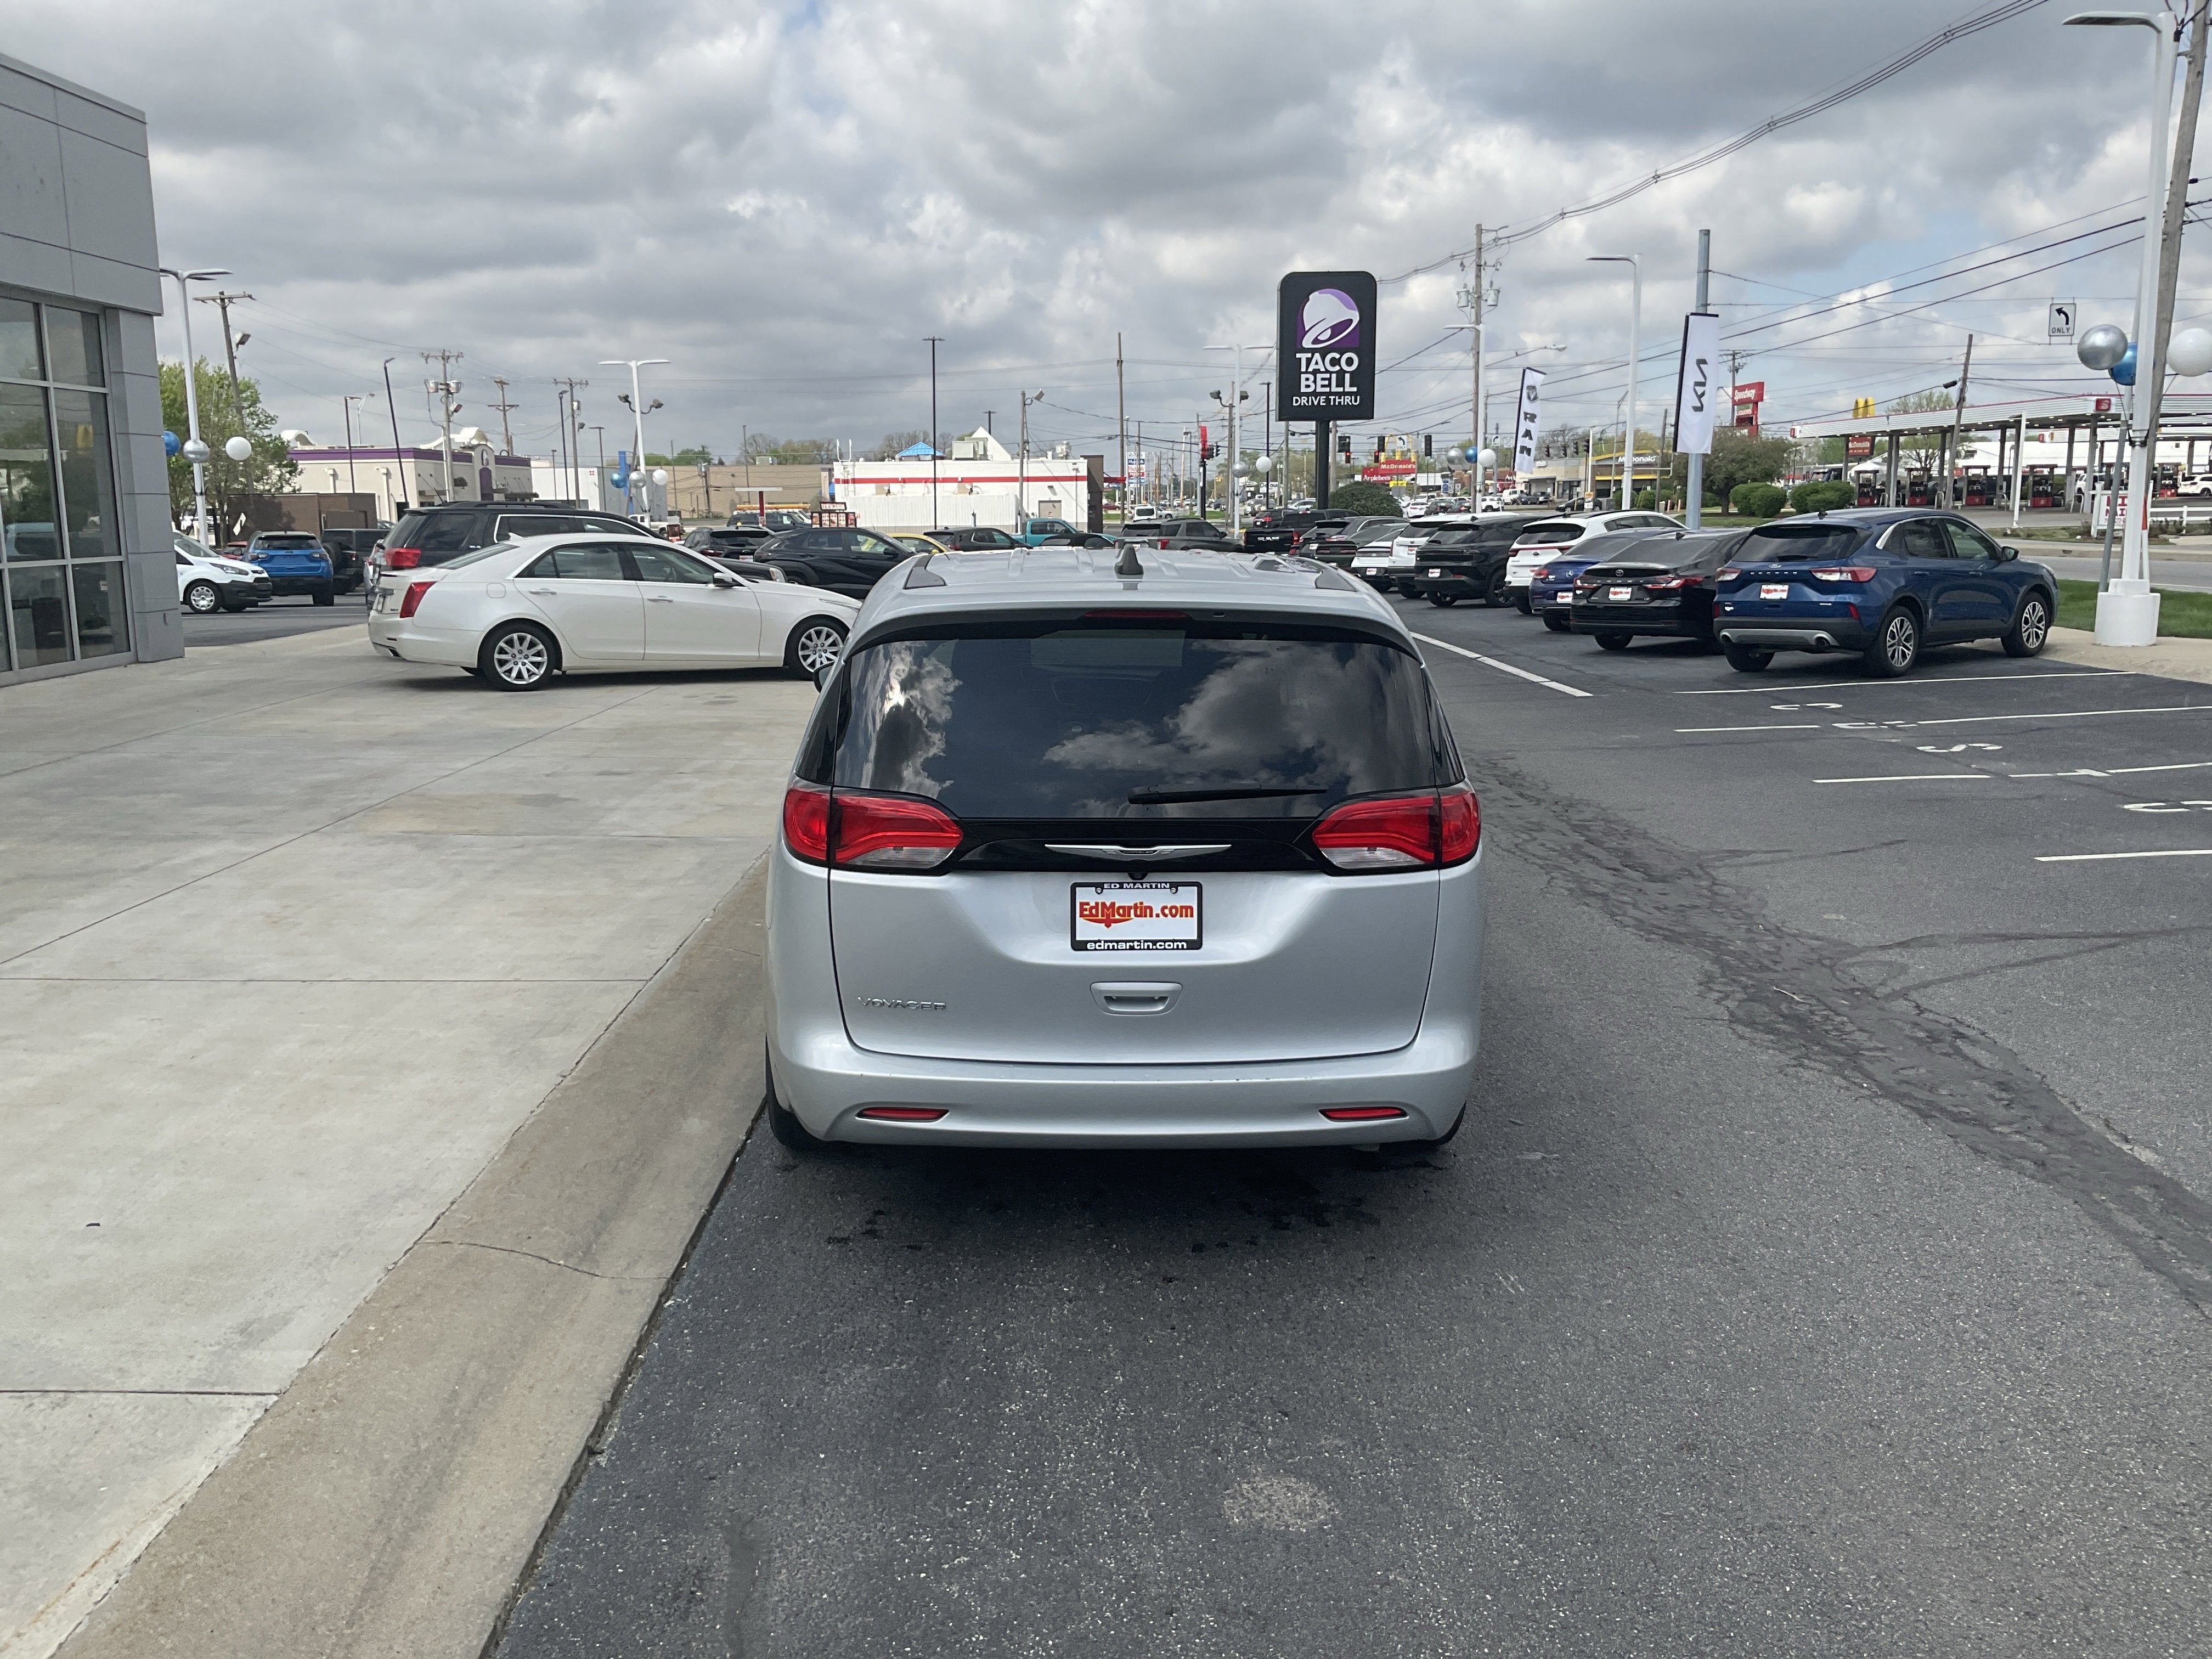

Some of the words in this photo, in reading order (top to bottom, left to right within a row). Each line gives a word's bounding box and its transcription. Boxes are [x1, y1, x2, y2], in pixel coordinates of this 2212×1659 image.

[1296, 352, 1359, 372] TACO
[1300, 373, 1357, 393] BELL
[1293, 396, 1326, 406] DRIVE
[1329, 396, 1360, 405] THRU
[1734, 388, 1756, 402] Speedway
[1519, 411, 1537, 457] RAM
[1079, 901, 1194, 923] EdMartin.com
[1087, 940, 1187, 950] edmartin.com
[857, 997, 947, 1011] VOYAGER
